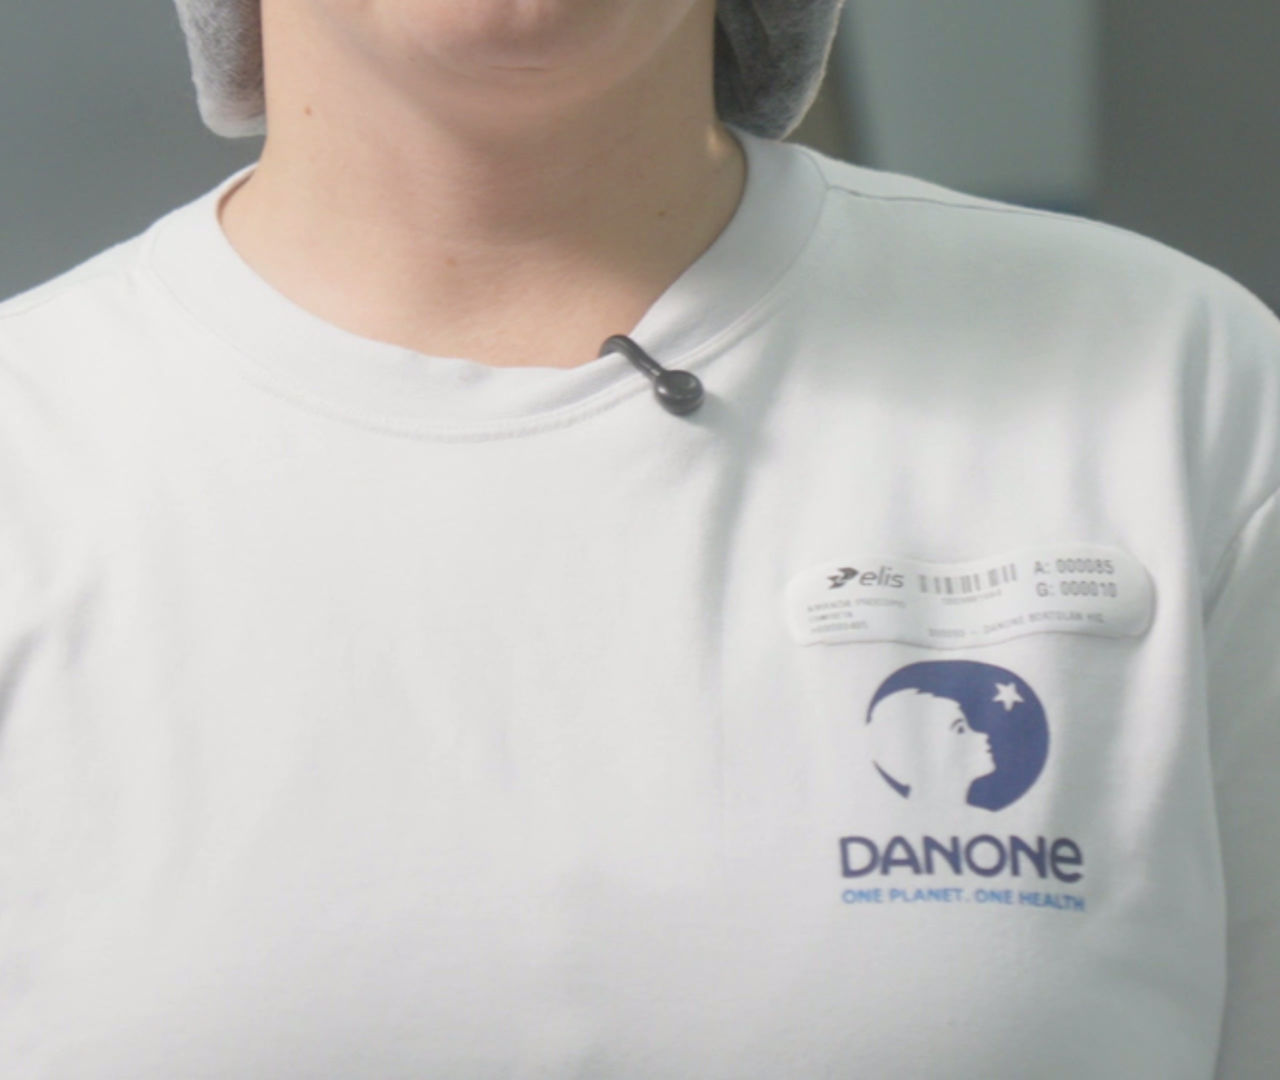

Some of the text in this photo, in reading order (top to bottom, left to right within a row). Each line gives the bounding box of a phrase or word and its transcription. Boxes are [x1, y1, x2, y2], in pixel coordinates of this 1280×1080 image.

[858, 565, 905, 589] elis
[1033, 560, 1050, 576] A:
[1036, 581, 1055, 598] G:
[841, 887, 1086, 911] ONE PLANET. ONE HEALTH
